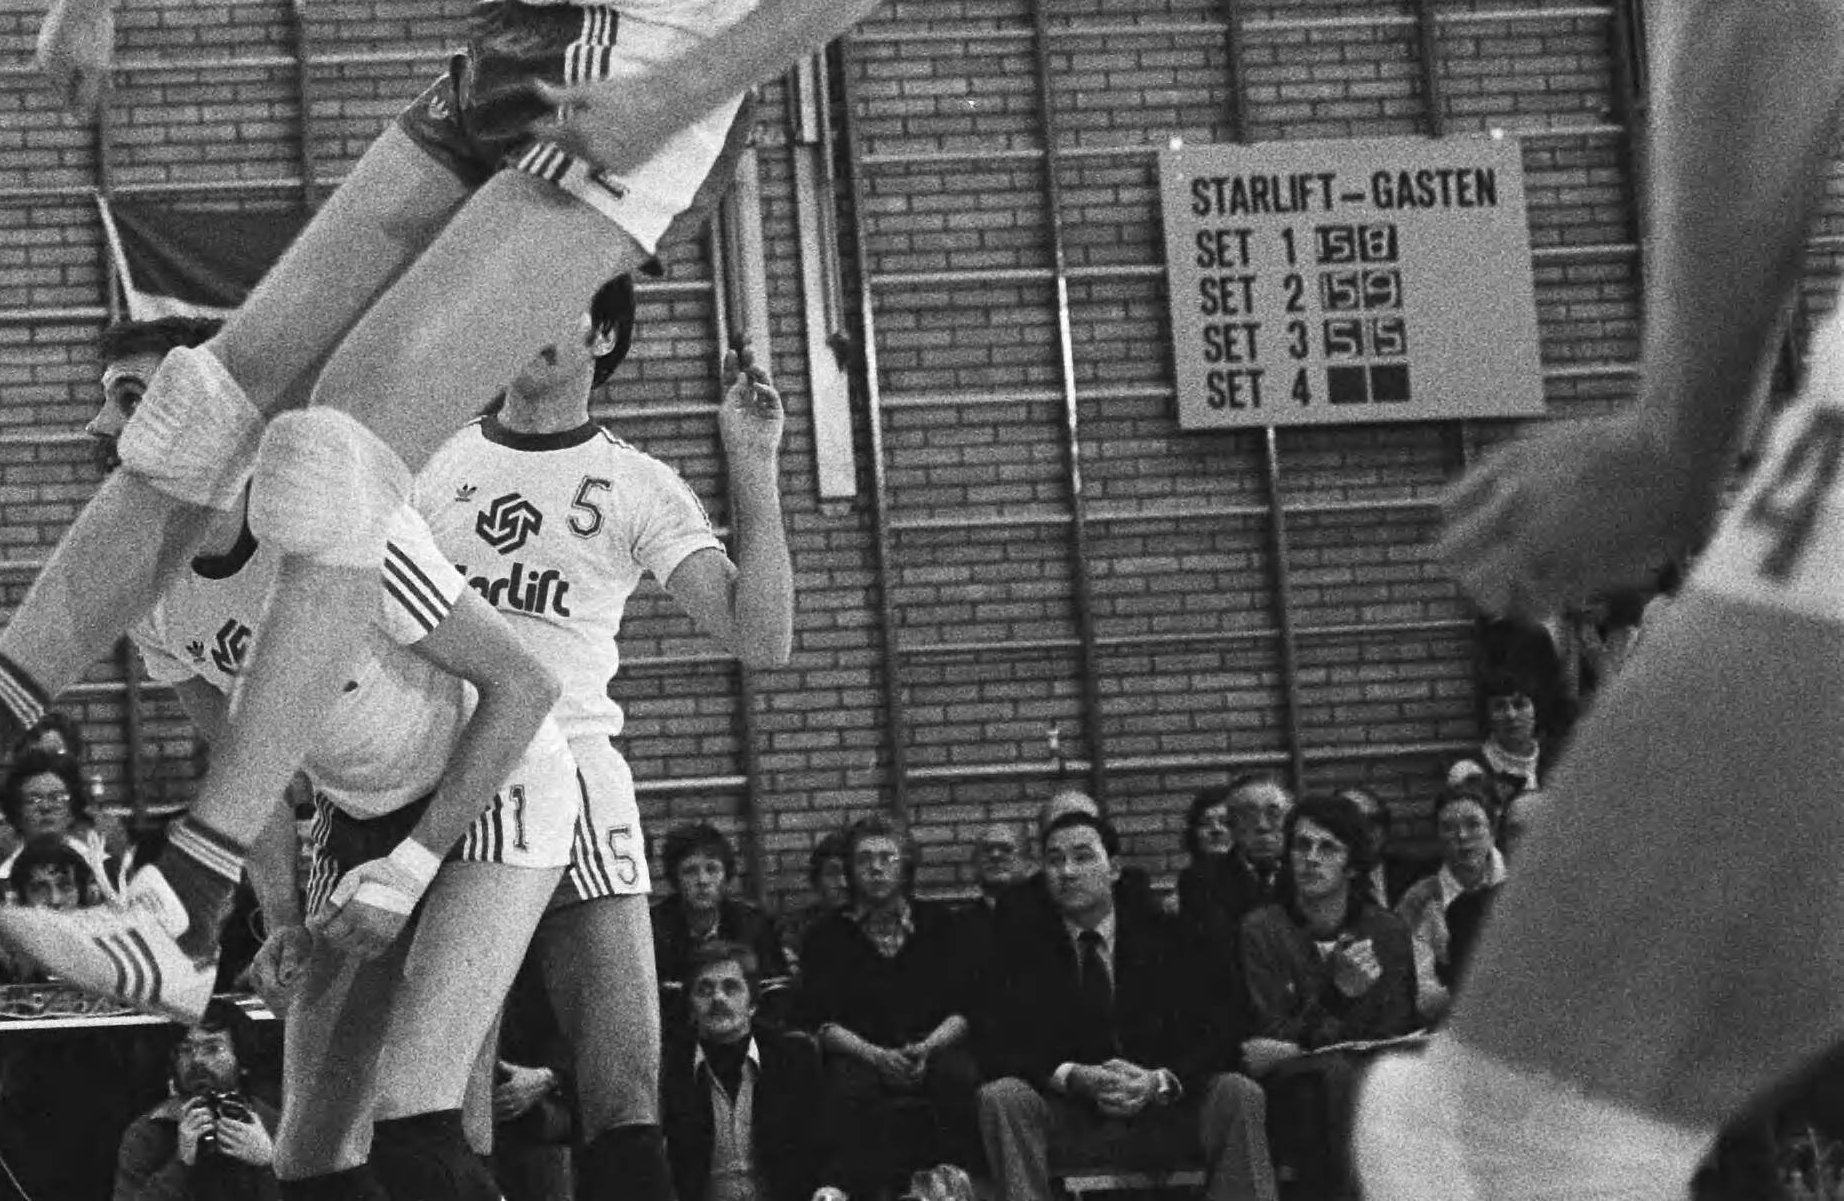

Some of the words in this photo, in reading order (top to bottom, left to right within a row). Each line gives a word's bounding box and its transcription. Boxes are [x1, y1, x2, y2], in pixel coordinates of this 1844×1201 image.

[1196, 228, 1254, 268] SET
[1282, 226, 1296, 266] 1
[1363, 225, 1390, 260] 8
[1199, 274, 1256, 316] SET
[1283, 272, 1306, 314] 2
[1364, 270, 1396, 310] 9
[1203, 321, 1262, 364] SET
[1287, 319, 1309, 360] 3
[1328, 321, 1357, 357] 5
[1206, 367, 1265, 410] SET
[1292, 367, 1312, 406] 4
[565, 474, 614, 540] 5
[454, 562, 571, 618] arlift
[509, 783, 530, 853] 1
[607, 824, 639, 887] 5
